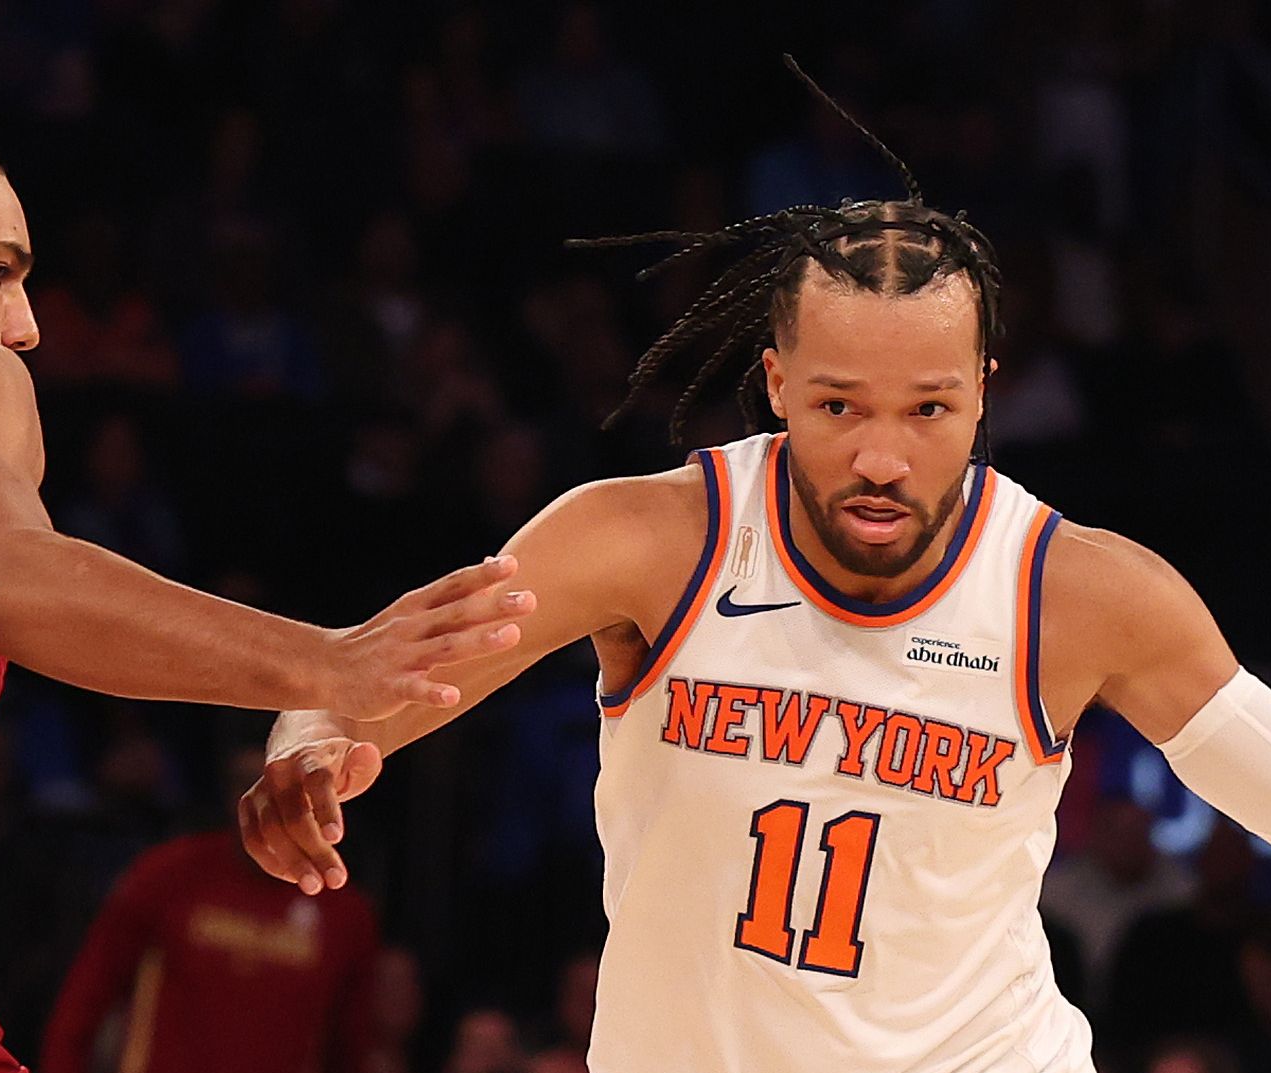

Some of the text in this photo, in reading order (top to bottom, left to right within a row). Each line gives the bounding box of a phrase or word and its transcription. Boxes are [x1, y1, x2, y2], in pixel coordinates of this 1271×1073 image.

[906, 646, 1000, 672] abu dhabi
[911, 636, 961, 650] experience
[661, 677, 1018, 808] NEW YORK
[734, 798, 881, 978] 11
